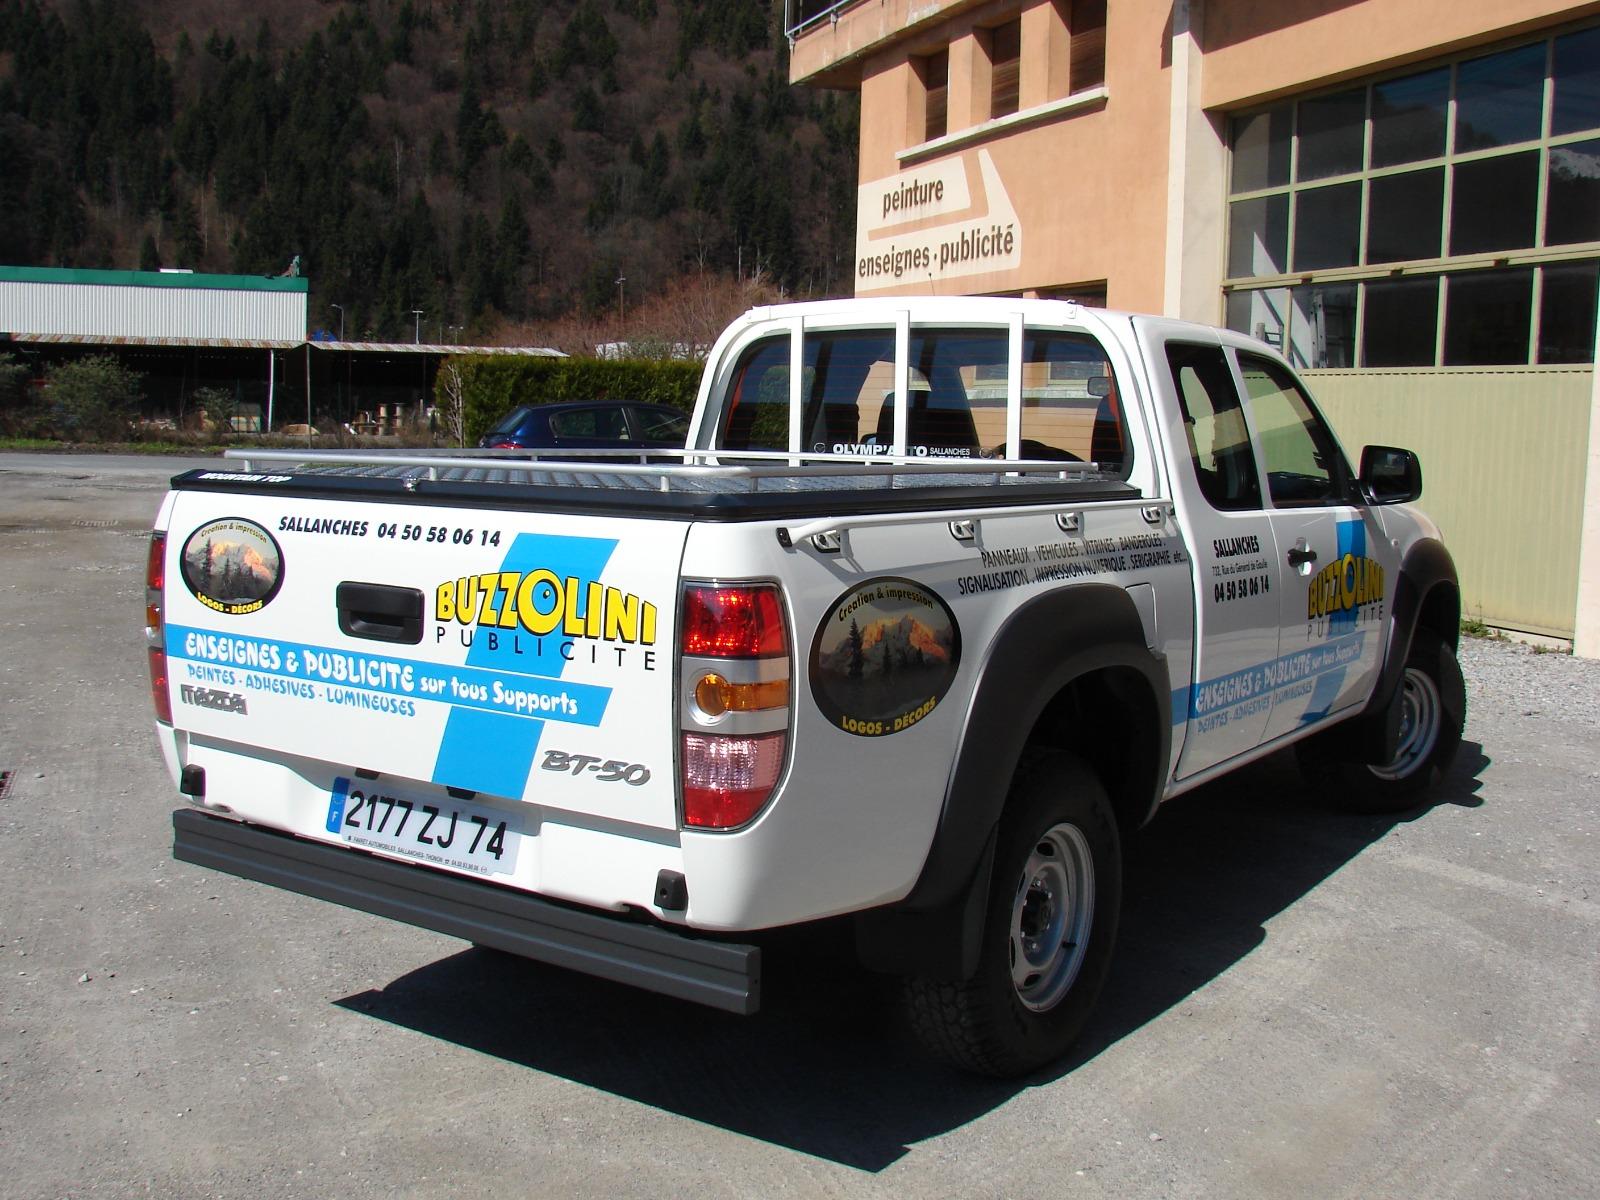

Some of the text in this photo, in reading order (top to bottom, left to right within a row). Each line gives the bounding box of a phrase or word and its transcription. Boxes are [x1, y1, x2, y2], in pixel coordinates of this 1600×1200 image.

[882, 178, 944, 219] peinture
[858, 224, 1014, 278] enseignes publicité
[929, 447, 970, 456] SALLANCHES
[235, 522, 267, 543] impression
[278, 515, 501, 547] SALLANCHES 04 50 58 06 14
[980, 532, 1163, 568] PANNEAUX VEHICULES VITRINES BANDEROLES
[1213, 535, 1260, 558] SALLANCHES
[957, 569, 1030, 595] SIGNALISATION
[1034, 560, 1084, 582] IMPRESSION
[1085, 555, 1127, 576] NUMERIQUE
[1130, 550, 1172, 570] SERIGRAPHIE
[1214, 574, 1270, 603] 04 50 58 06 14
[1307, 553, 1385, 620] BUZZOLINI
[197, 592, 224, 611] LOGOS
[435, 568, 659, 646] BUZZOLINI
[838, 585, 935, 622] Creation & impression
[436, 626, 656, 671] PUBLICITE
[185, 632, 579, 715] ENSEIGNES & PUBLICITE sur tous Supports
[187, 663, 417, 718] PEINTES ADHESIVES LUMINEUSES
[1196, 671, 1254, 713] ENSEIGNES
[1263, 652, 1312, 690] PUBLICITE
[841, 695, 937, 735] LOGOS DÉCORS
[541, 748, 652, 788] BT-50
[344, 789, 508, 860] 2177 ZJ 74
